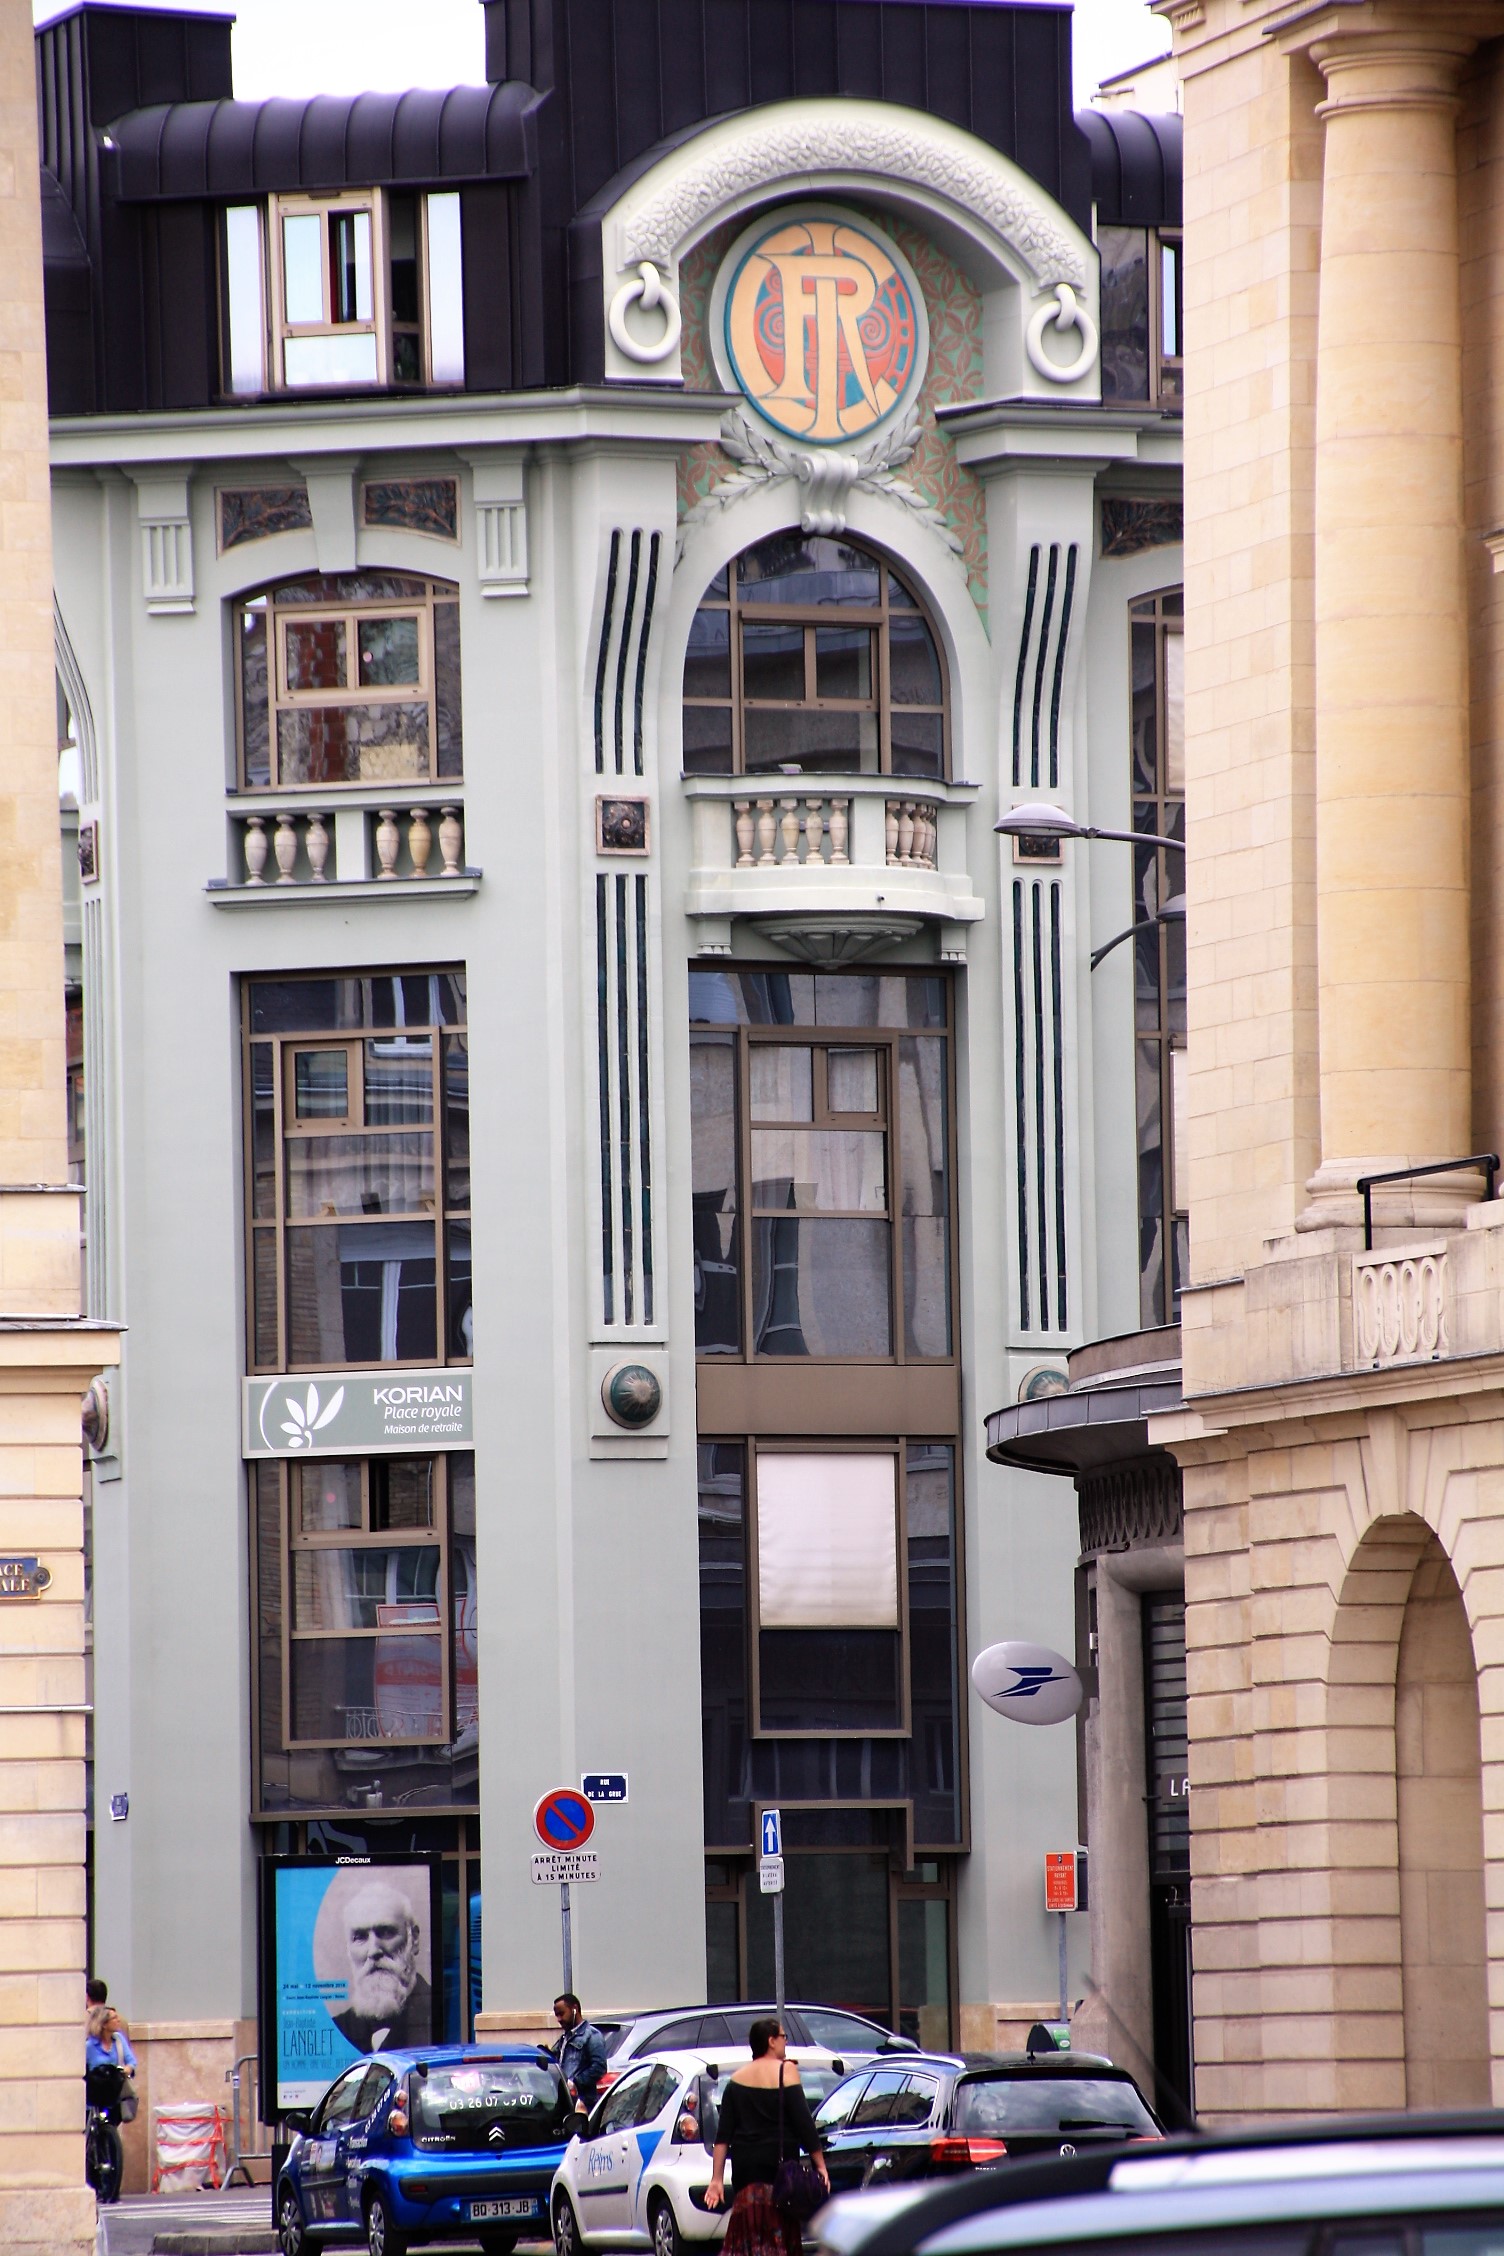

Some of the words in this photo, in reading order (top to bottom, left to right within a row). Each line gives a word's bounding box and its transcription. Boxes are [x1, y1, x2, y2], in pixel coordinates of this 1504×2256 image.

[373, 1385, 463, 1405] KORIAN
[384, 1406, 418, 1419] Place
[421, 1404, 462, 1421] royale
[384, 1425, 416, 1434] Maison
[418, 1424, 430, 1433] de
[431, 1422, 463, 1433] retraite
[598, 1790, 605, 1798] LA
[335, 1856, 371, 1864] JCDecaux
[534, 1855, 561, 1864] ARRÊT
[565, 1854, 597, 1863] MINUTE
[551, 1863, 580, 1872] LIMITÉ
[537, 1872, 542, 1881] À
[545, 1873, 555, 1881] 15
[558, 1871, 596, 1880] MINUTES
[283, 2028, 335, 2057] LANGLET
[468, 2097, 482, 2108] 26
[519, 2094, 534, 2106] 07
[588, 2147, 613, 2177] Reims
